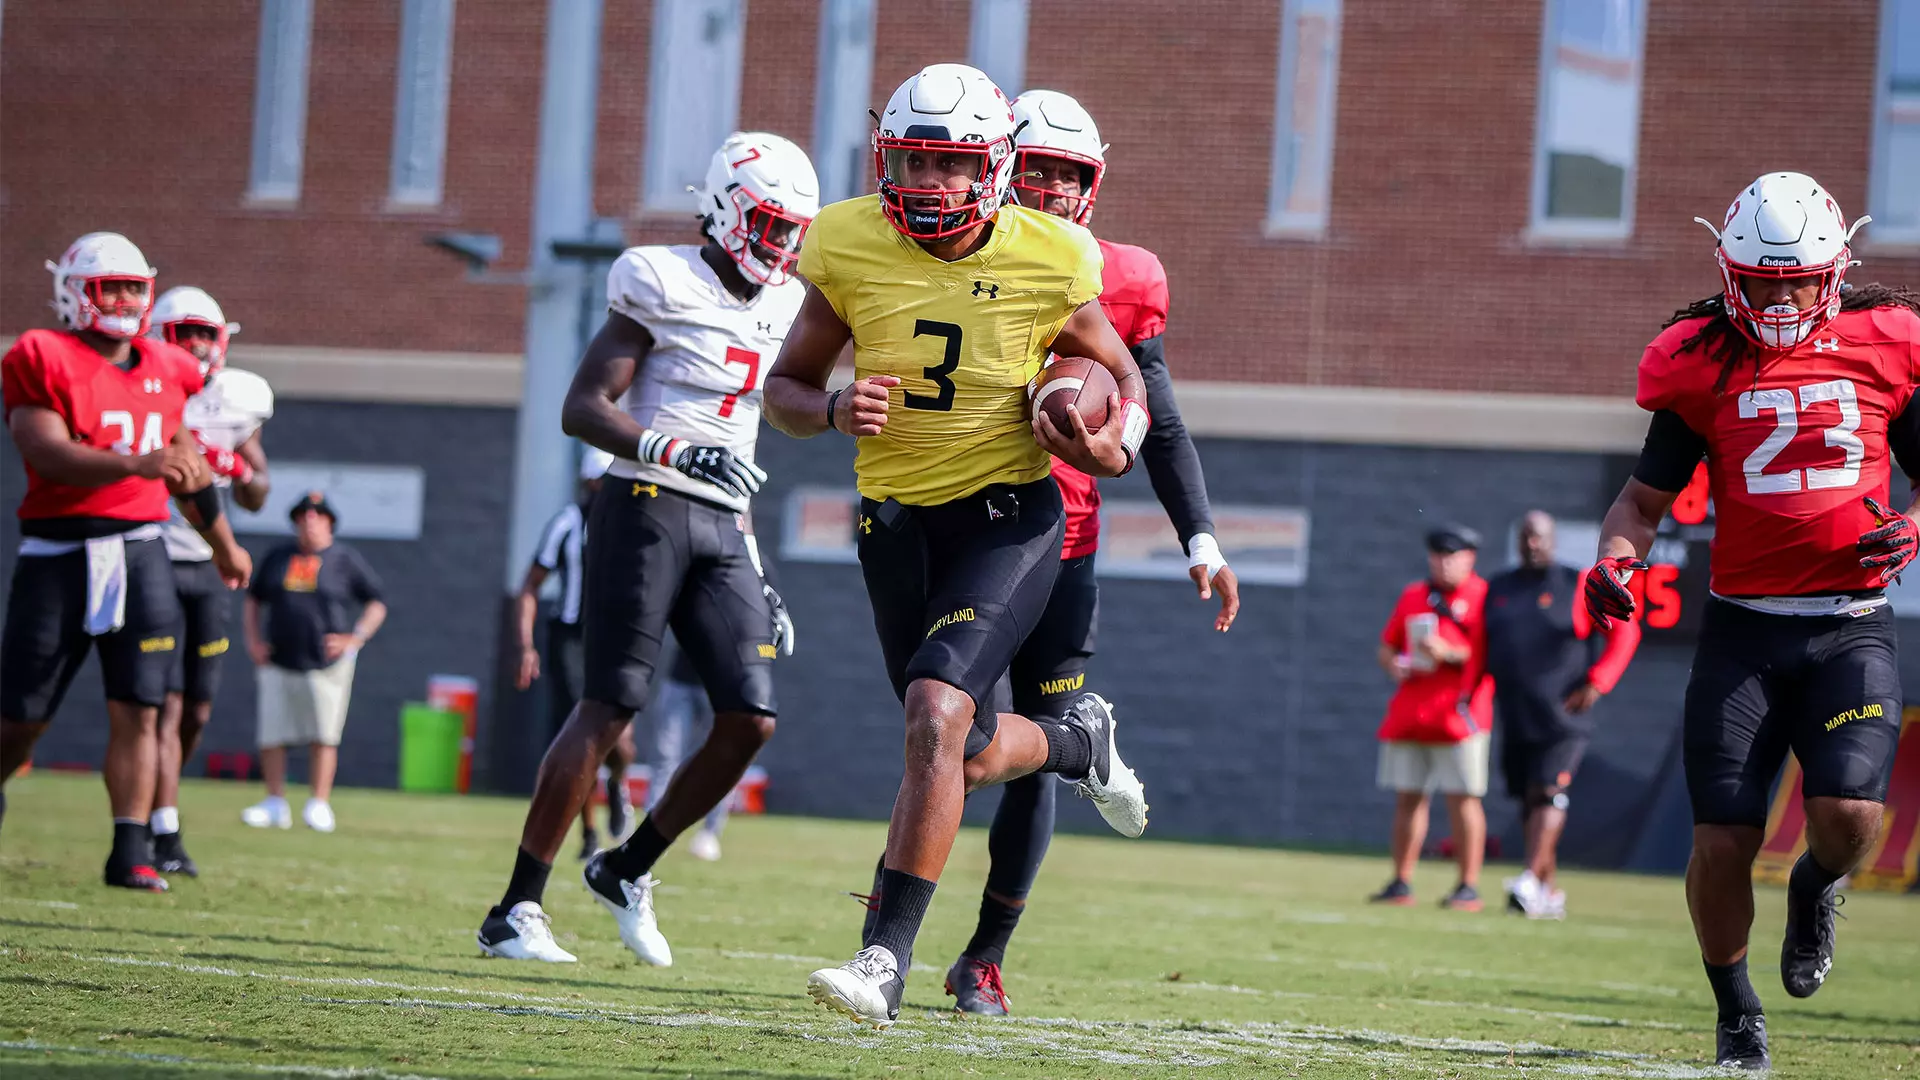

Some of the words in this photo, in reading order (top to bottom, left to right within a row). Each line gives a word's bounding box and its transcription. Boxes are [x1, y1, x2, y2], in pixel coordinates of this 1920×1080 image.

[732, 147, 761, 169] 7
[1762, 257, 1797, 266] Riddell
[718, 346, 761, 418] 7
[903, 319, 963, 412] 3
[101, 409, 163, 456] 34
[1738, 379, 1865, 494] 23
[1824, 703, 1883, 732] MARYLAND
